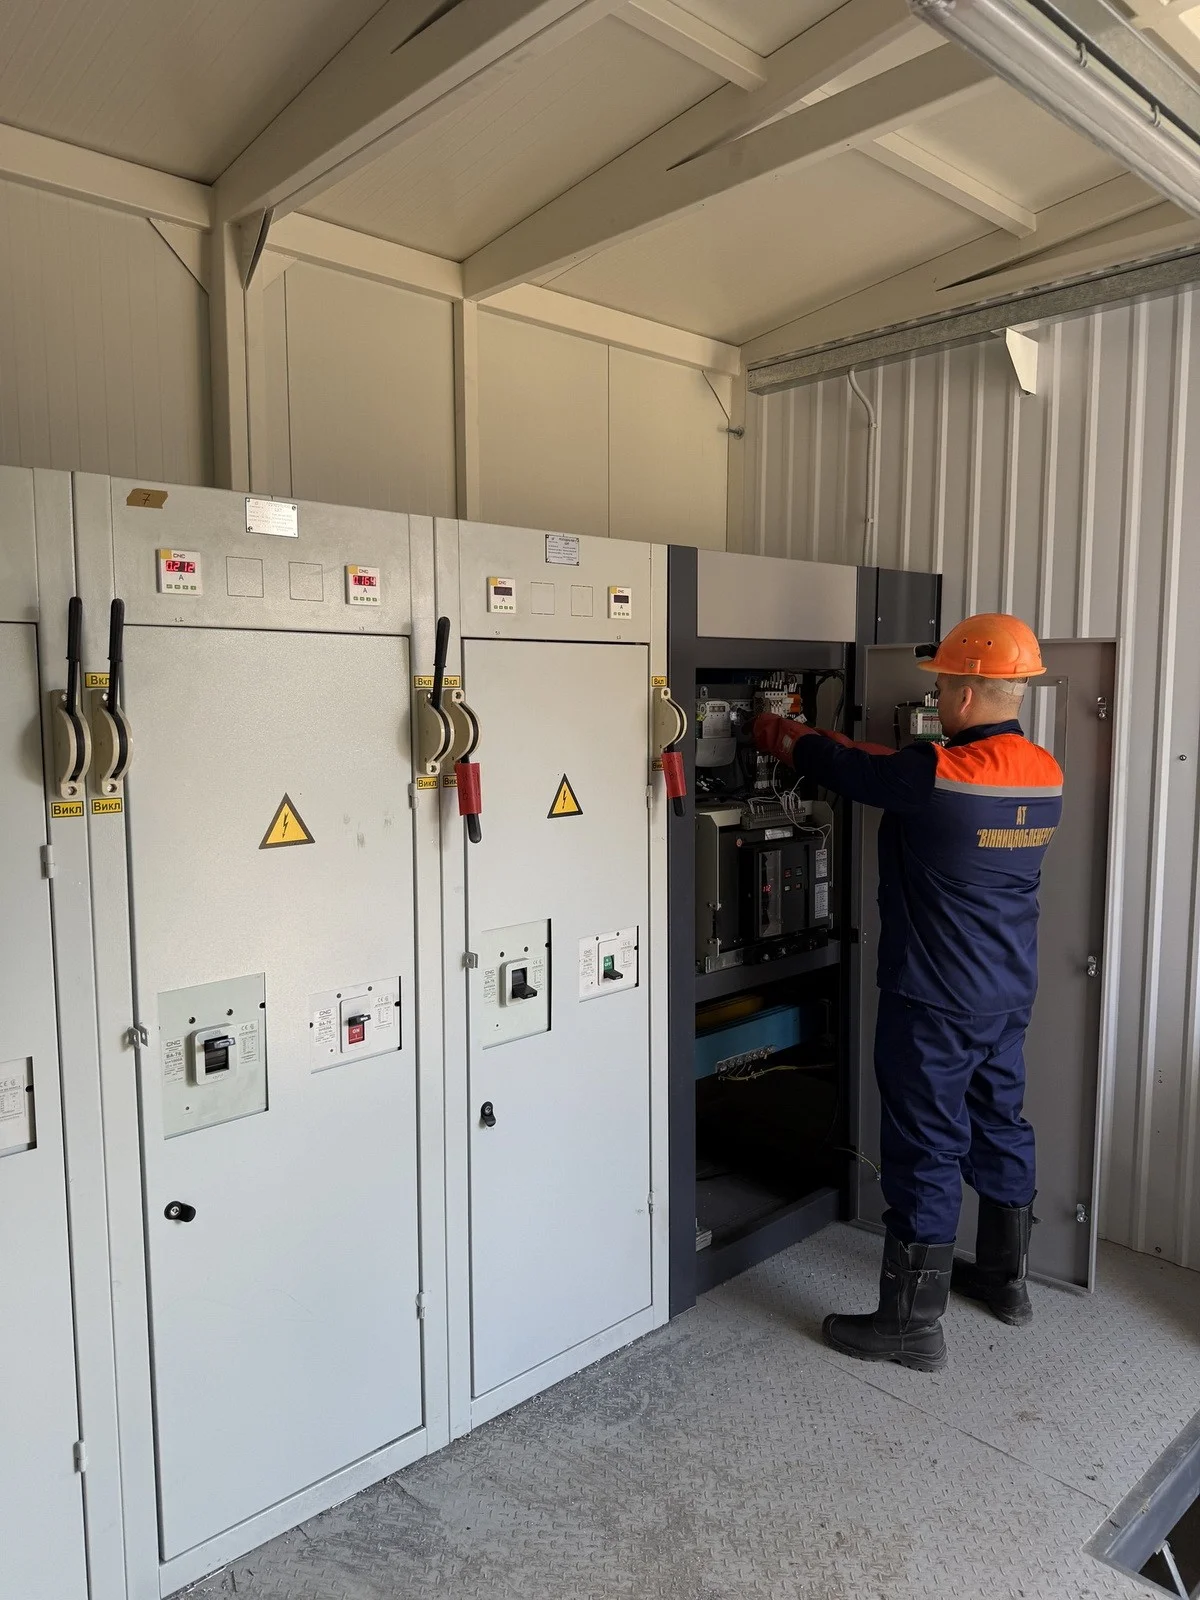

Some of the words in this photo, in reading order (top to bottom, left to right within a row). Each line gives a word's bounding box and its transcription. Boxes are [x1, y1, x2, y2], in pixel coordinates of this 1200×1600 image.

[142, 492, 151, 505] 7
[417, 678, 432, 686] Вкл
[443, 677, 458, 686] Вкл
[418, 779, 437, 788] Викл
[53, 805, 82, 815] Викл
[94, 801, 121, 812] Викл
[1016, 805, 1027, 825] АТ
[166, 1039, 181, 1048] CNC
